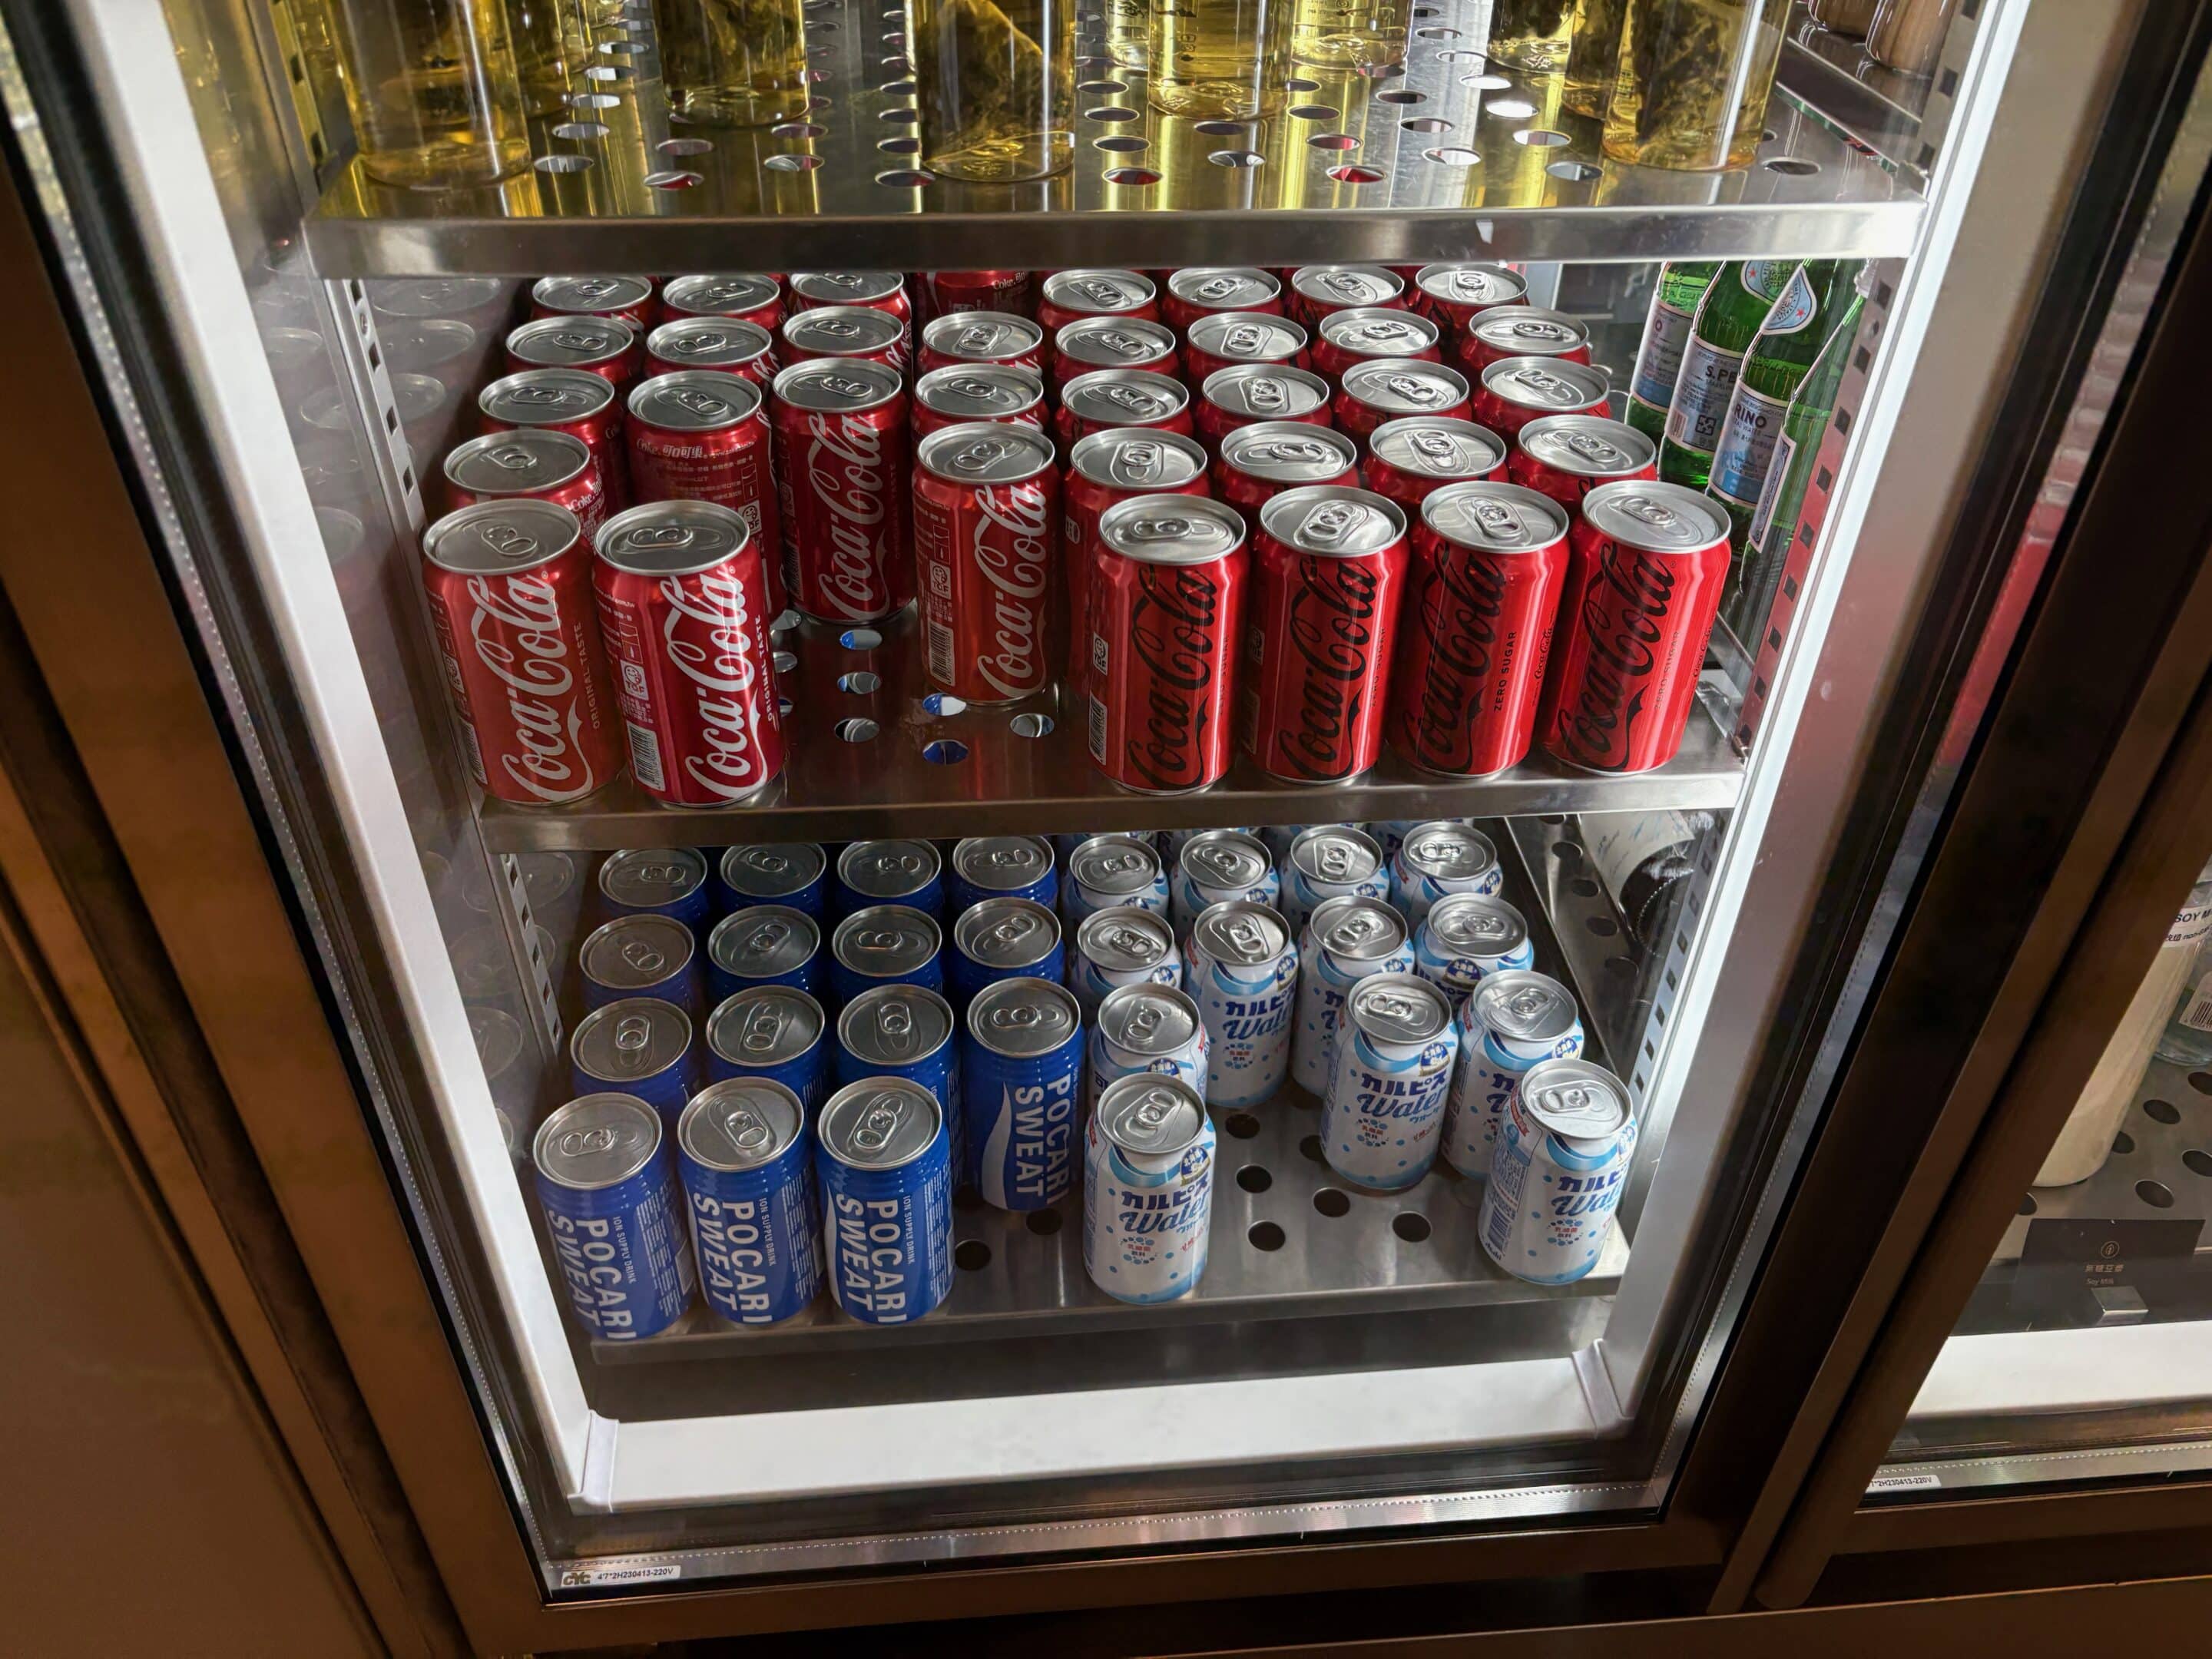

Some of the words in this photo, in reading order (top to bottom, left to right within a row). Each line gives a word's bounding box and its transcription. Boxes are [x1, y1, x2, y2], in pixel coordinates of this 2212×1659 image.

[574, 622, 588, 665] TASTE
[1494, 680, 1506, 712] ZERO
[1502, 631, 1517, 674] SUGAR
[584, 665, 600, 729] ORIGINAL
[1356, 1085, 1448, 1118] Water
[1362, 1069, 1448, 1096] カルピス
[1015, 1086, 1045, 1198] SWEAT
[1046, 1073, 1071, 1205] POCARI
[759, 1197, 768, 1212] ION
[762, 1213, 773, 1243] SUPPLY
[904, 1211, 912, 1242] SUPPLY
[1118, 1185, 1211, 1234] Water
[548, 1210, 601, 1327] SWEAT
[576, 1219, 637, 1339] POCARI
[616, 1233, 631, 1260] SUPPLY
[624, 1260, 637, 1284] DRINK
[694, 1193, 737, 1310] SWEAT
[722, 1201, 773, 1323] POCARI
[766, 1243, 777, 1266] DRINK
[836, 1194, 873, 1311] SWEAT
[866, 1199, 907, 1323] POCARI
[907, 1241, 916, 1264] DRINK
